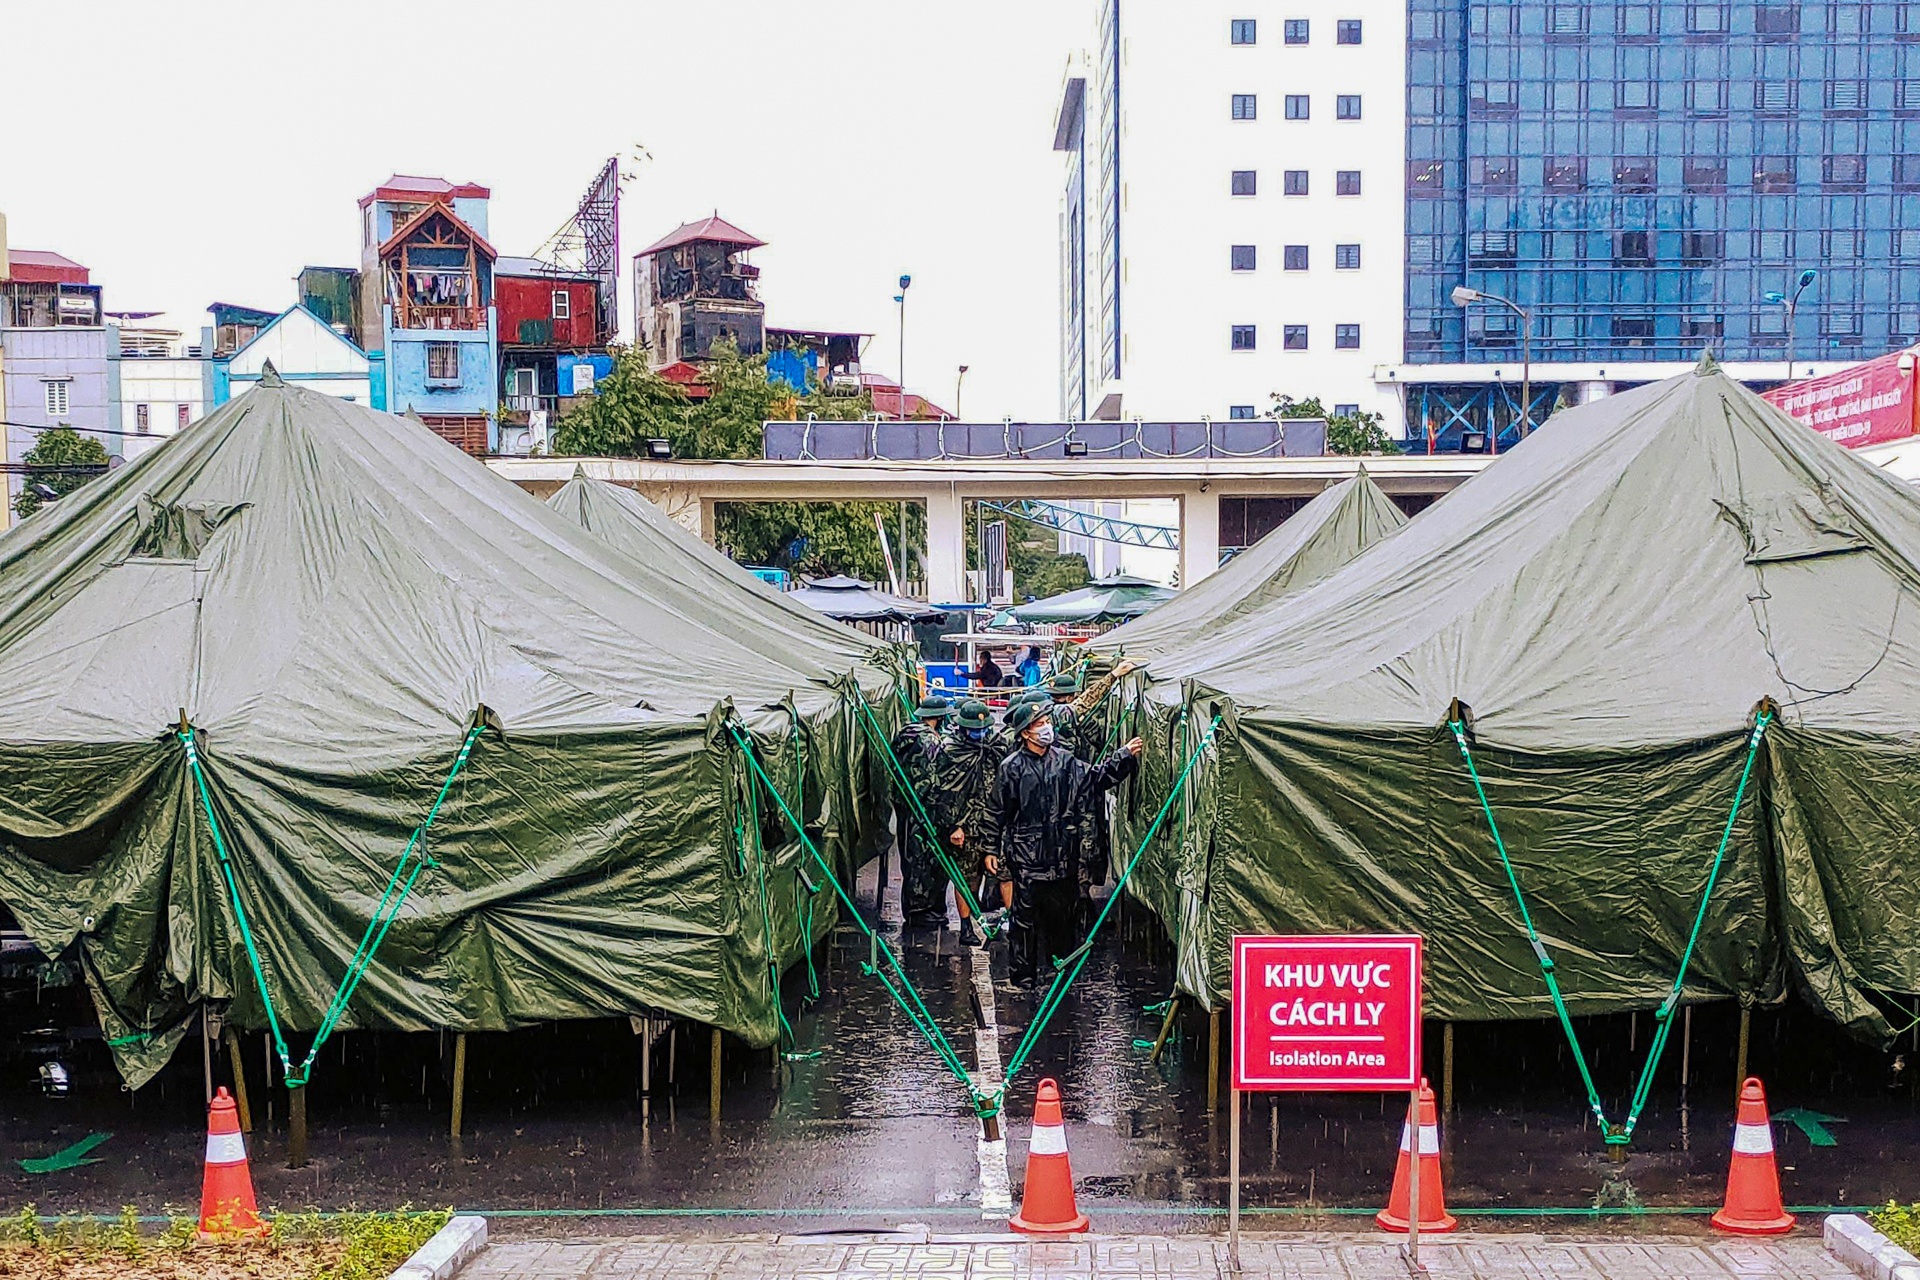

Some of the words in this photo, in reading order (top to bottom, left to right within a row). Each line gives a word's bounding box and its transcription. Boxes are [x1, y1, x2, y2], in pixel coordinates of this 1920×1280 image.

[1265, 964, 1324, 988] KHU
[1329, 961, 1391, 994] VỰC
[1269, 997, 1346, 1026] CÁCH
[1354, 1002, 1386, 1026] LY
[1269, 1050, 1342, 1066] Isolation
[1346, 1051, 1386, 1066] Area
